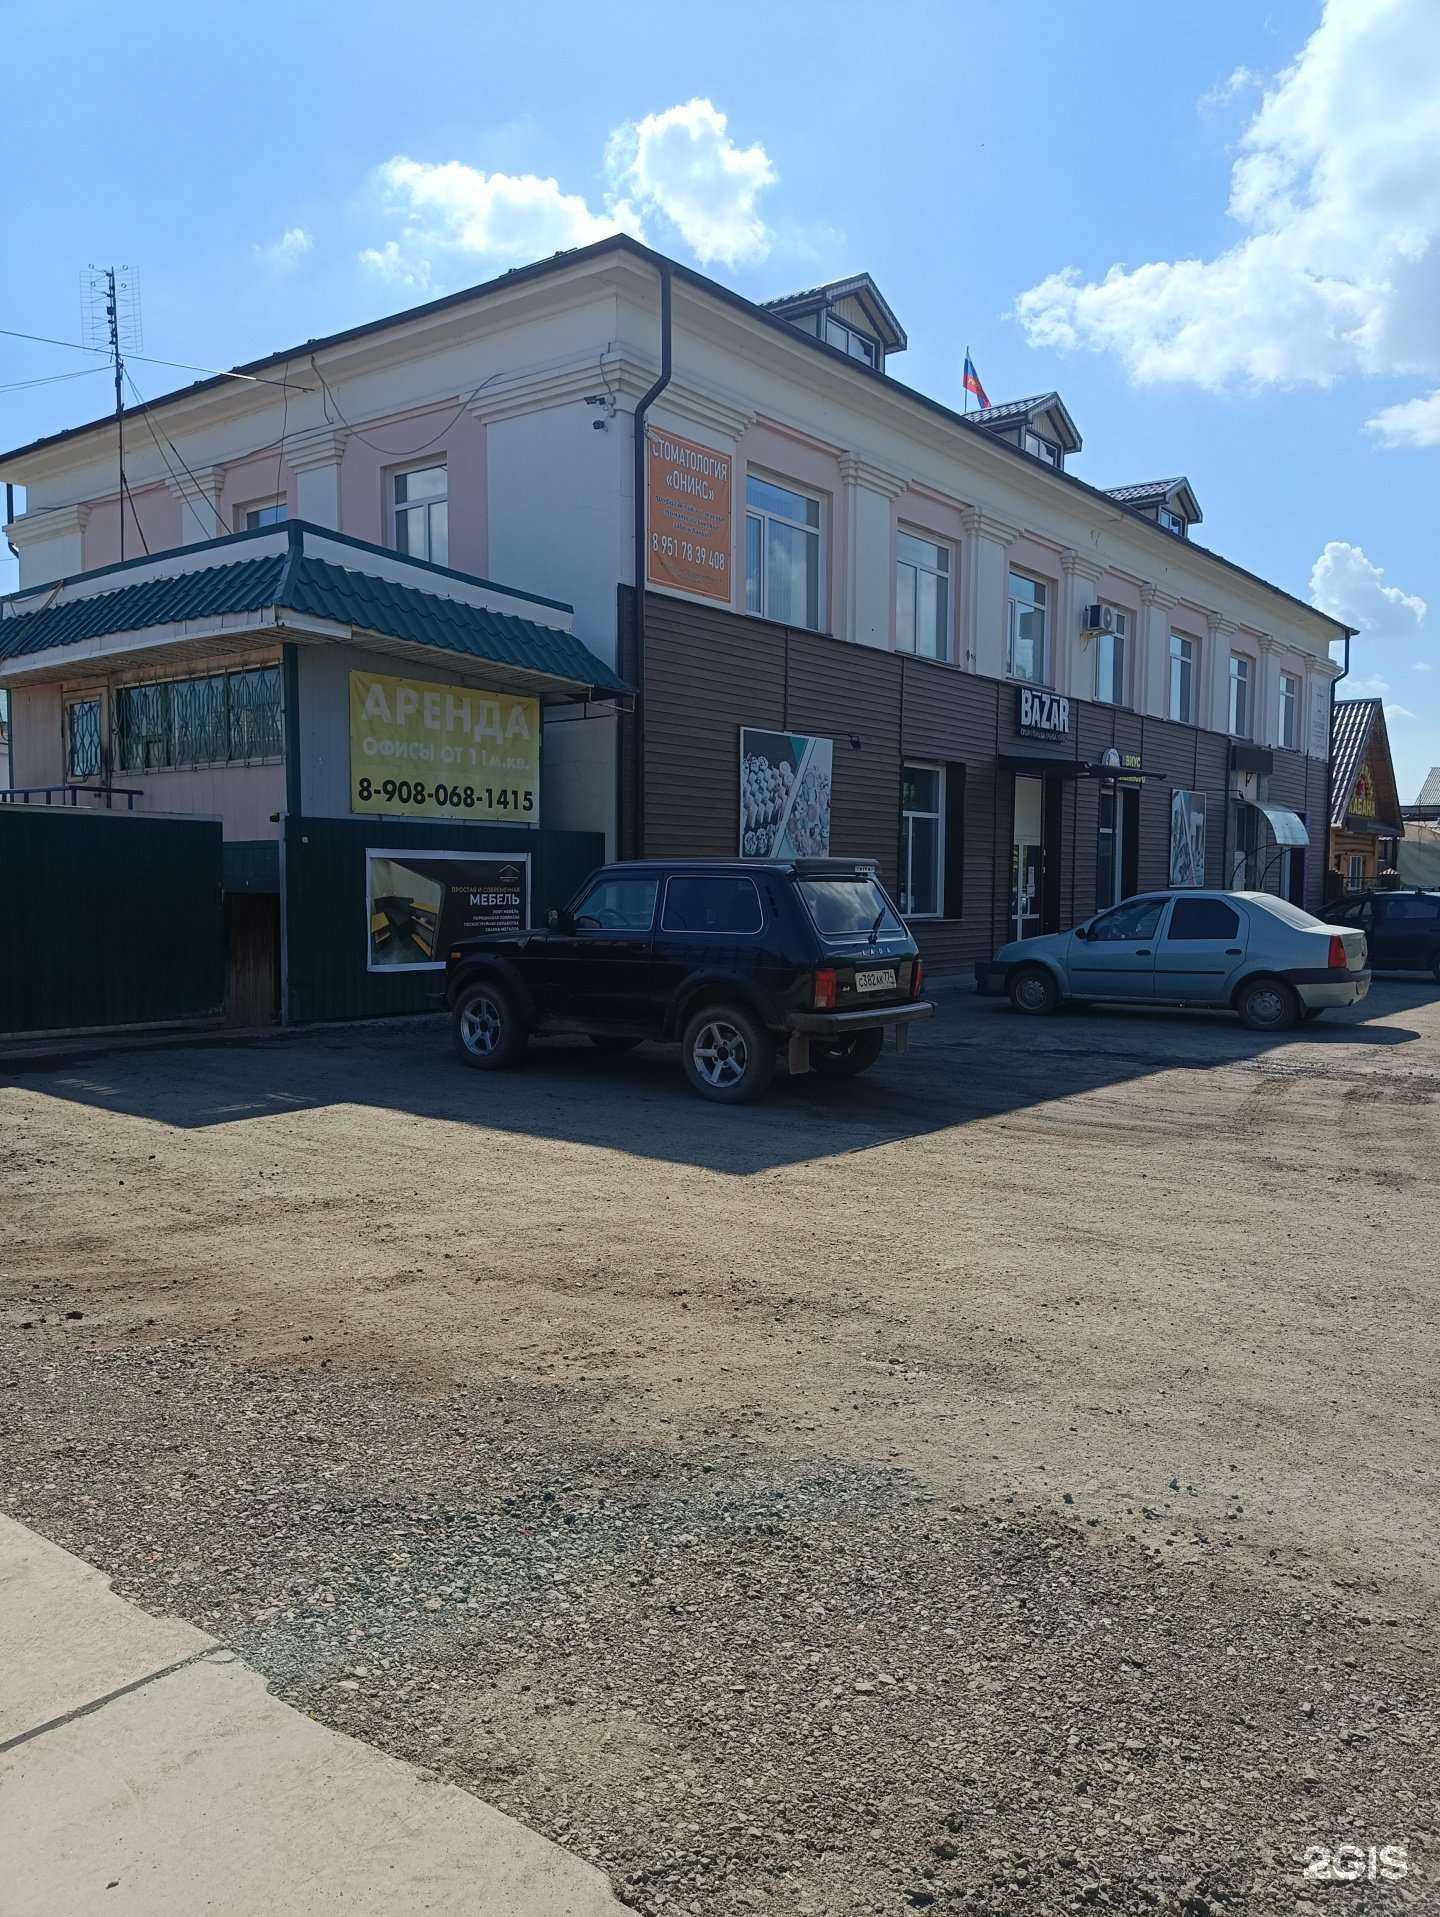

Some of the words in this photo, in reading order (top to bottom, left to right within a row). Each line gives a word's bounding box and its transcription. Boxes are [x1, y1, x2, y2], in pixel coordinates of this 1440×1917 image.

[652, 438, 727, 480] СТОМАТОЛОГИЯ
[666, 470, 714, 499] «ОНИКС»
[652, 533, 659, 551] 8
[661, 535, 678, 558] 951
[681, 541, 693, 561] 78
[695, 546, 706, 565] 39
[708, 550, 725, 571] 408
[362, 683, 530, 744] АРЕНДА
[358, 777, 534, 811] 8-908-068-1415
[470, 893, 520, 906] МЕБЕЛЬ
